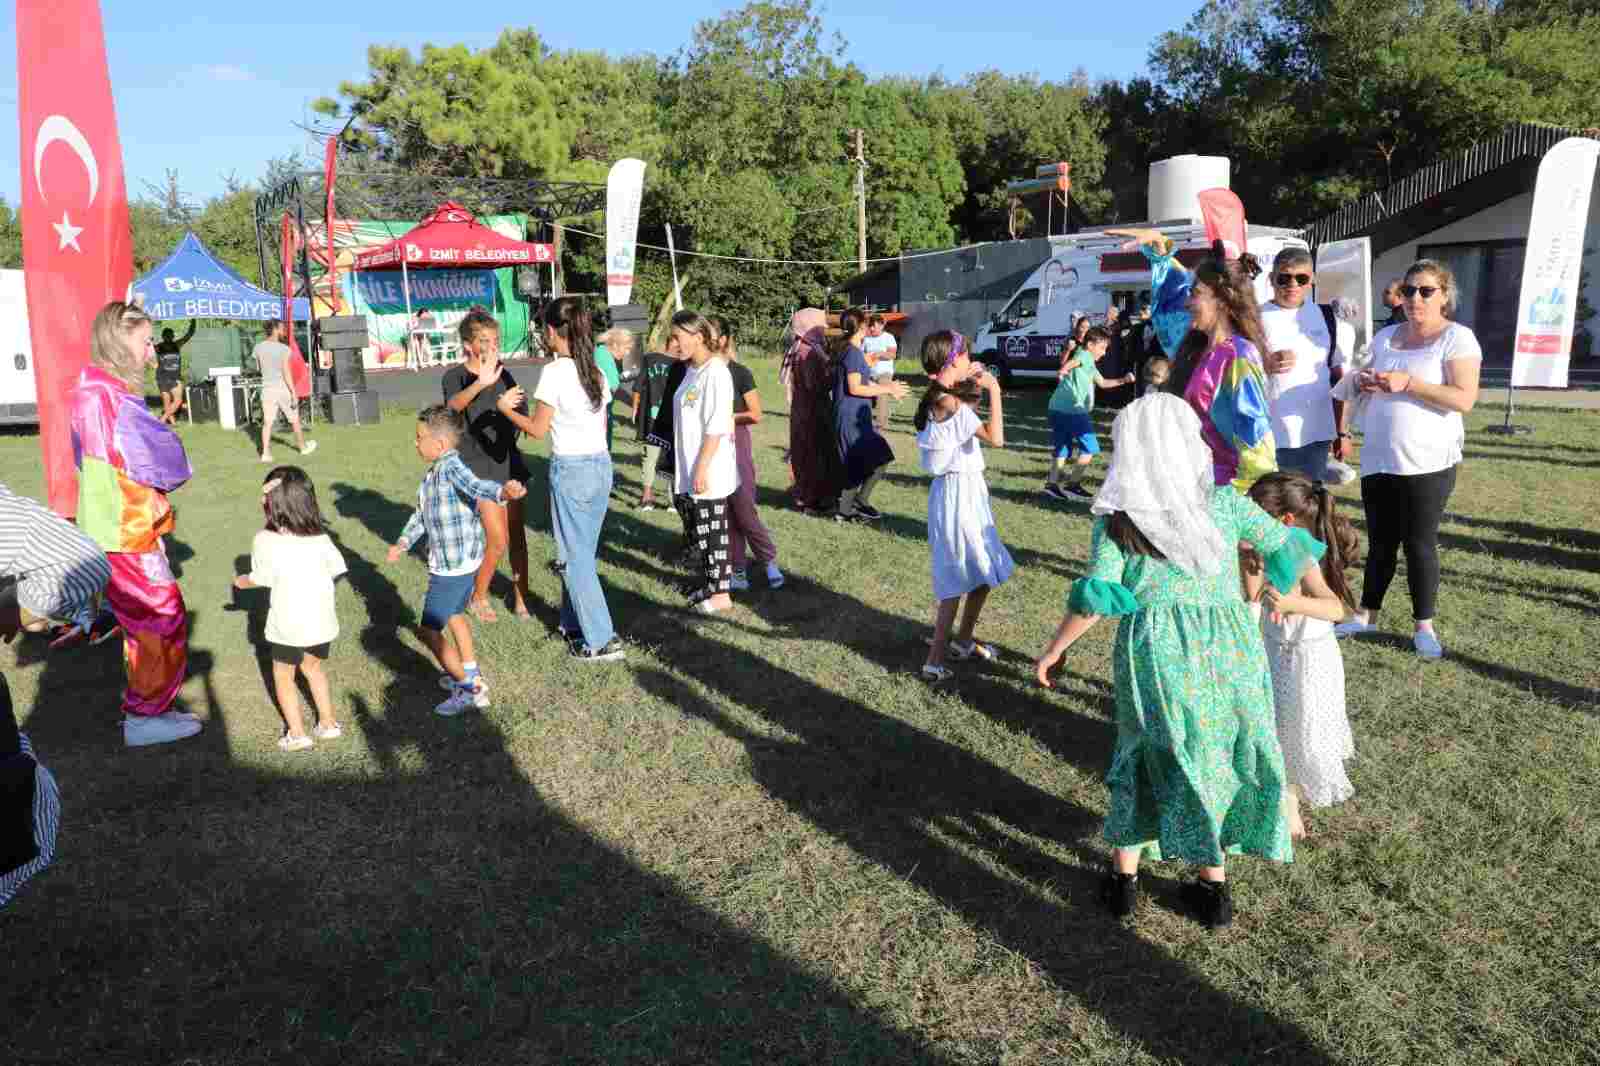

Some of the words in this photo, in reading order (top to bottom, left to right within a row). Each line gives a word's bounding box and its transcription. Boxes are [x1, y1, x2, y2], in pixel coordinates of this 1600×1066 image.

[429, 247, 459, 260] İZMİT
[464, 247, 530, 260] BELEDİYESİ
[144, 299, 176, 318] MİT
[185, 299, 281, 318] BELEDİYES
